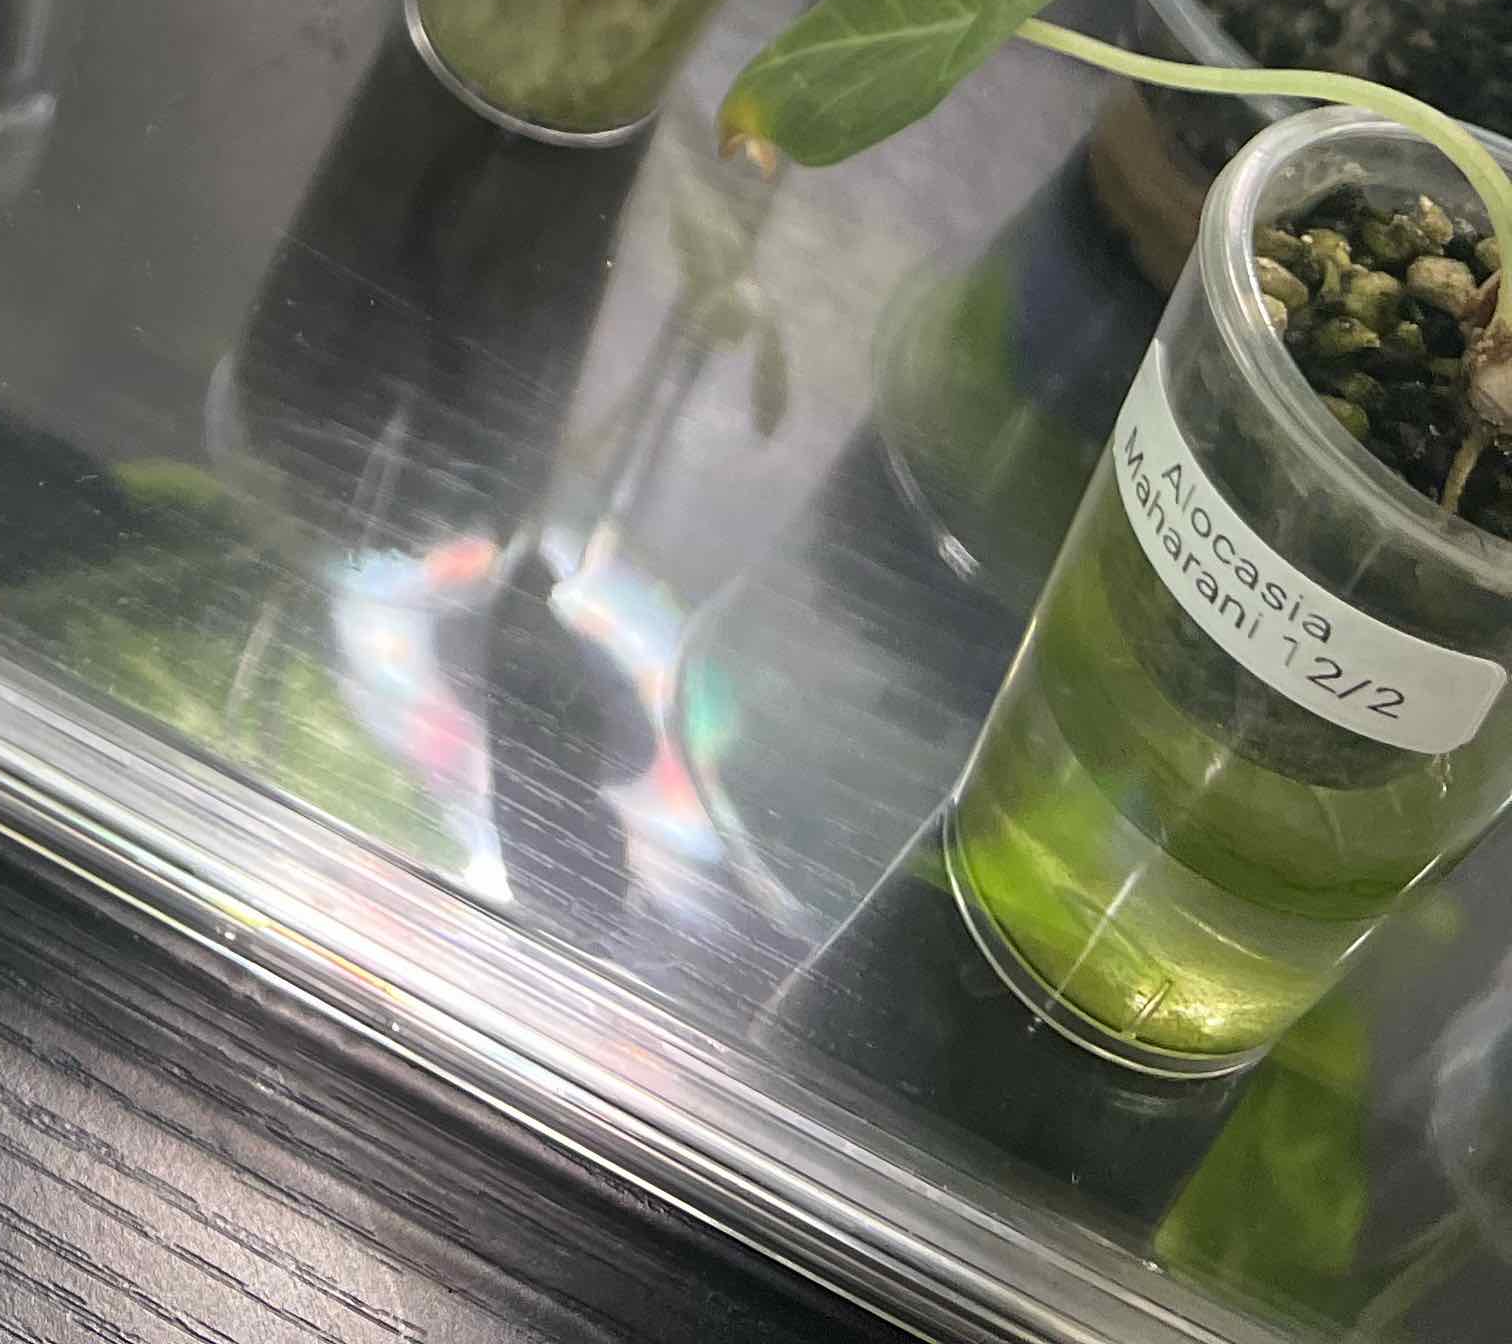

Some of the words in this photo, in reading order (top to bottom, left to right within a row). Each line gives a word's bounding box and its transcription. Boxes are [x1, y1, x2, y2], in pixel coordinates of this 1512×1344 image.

[1123, 426, 1264, 639] Maharani
[1283, 636, 1405, 719] 12/2
[1161, 463, 1332, 644] Alocasia
